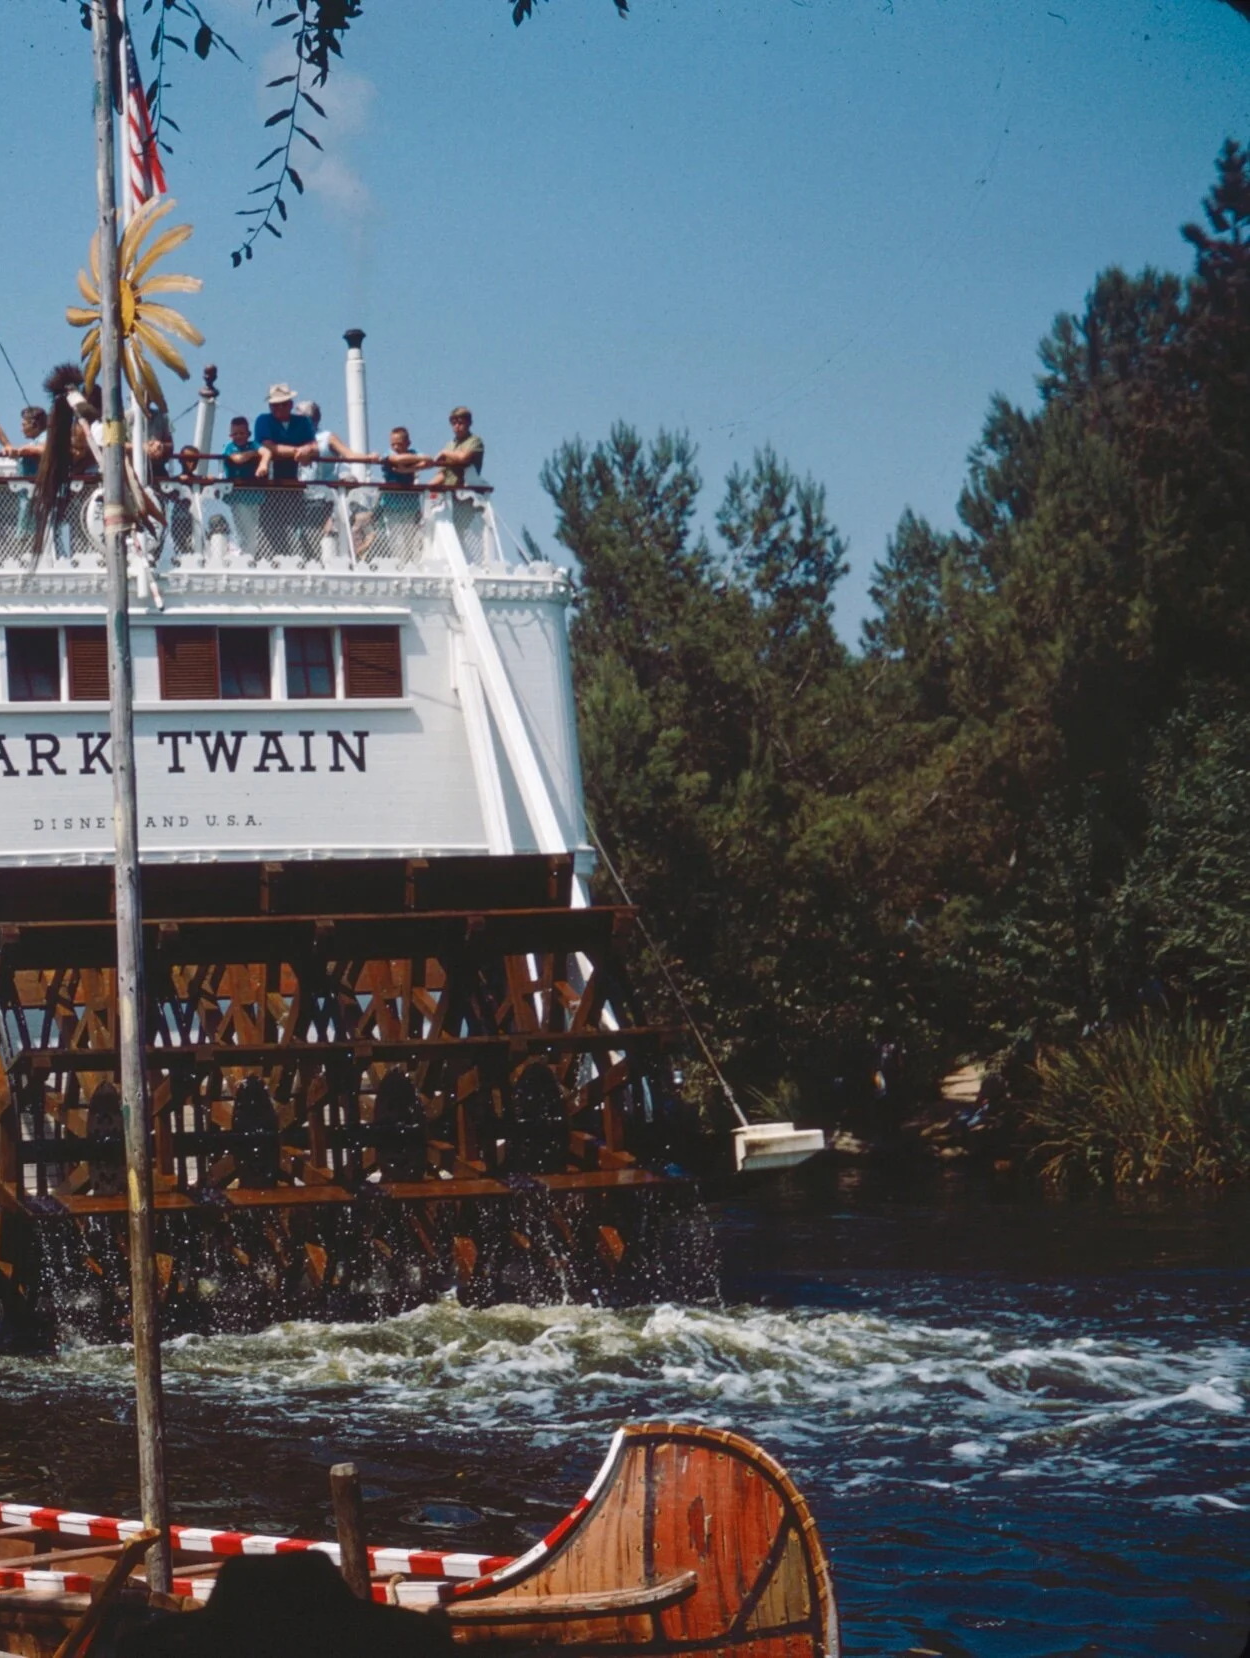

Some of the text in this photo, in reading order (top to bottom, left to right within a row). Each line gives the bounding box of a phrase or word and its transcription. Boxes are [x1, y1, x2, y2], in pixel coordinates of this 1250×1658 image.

[157, 730, 370, 773] TWAIN
[33, 814, 263, 830] DISNEAND U.S.A.
